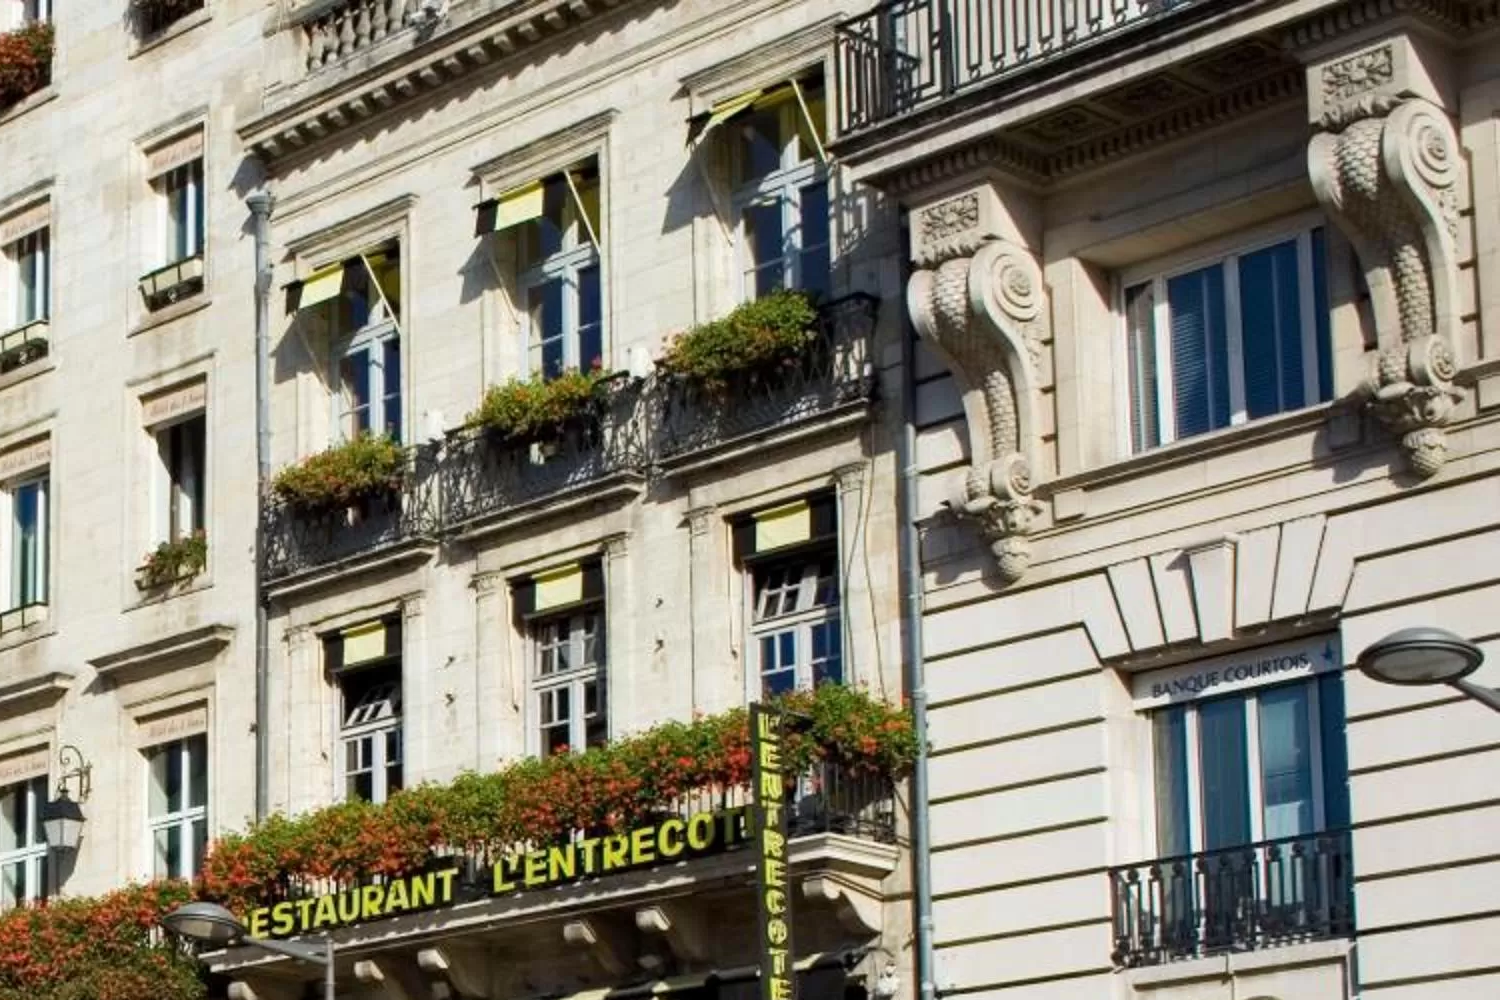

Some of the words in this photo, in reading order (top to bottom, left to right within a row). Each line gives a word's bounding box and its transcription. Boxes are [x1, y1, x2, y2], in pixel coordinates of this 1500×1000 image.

[1153, 671, 1219, 698] BANQUE
[1223, 652, 1310, 683] COURTOIS
[242, 867, 459, 939] ESTAURANT
